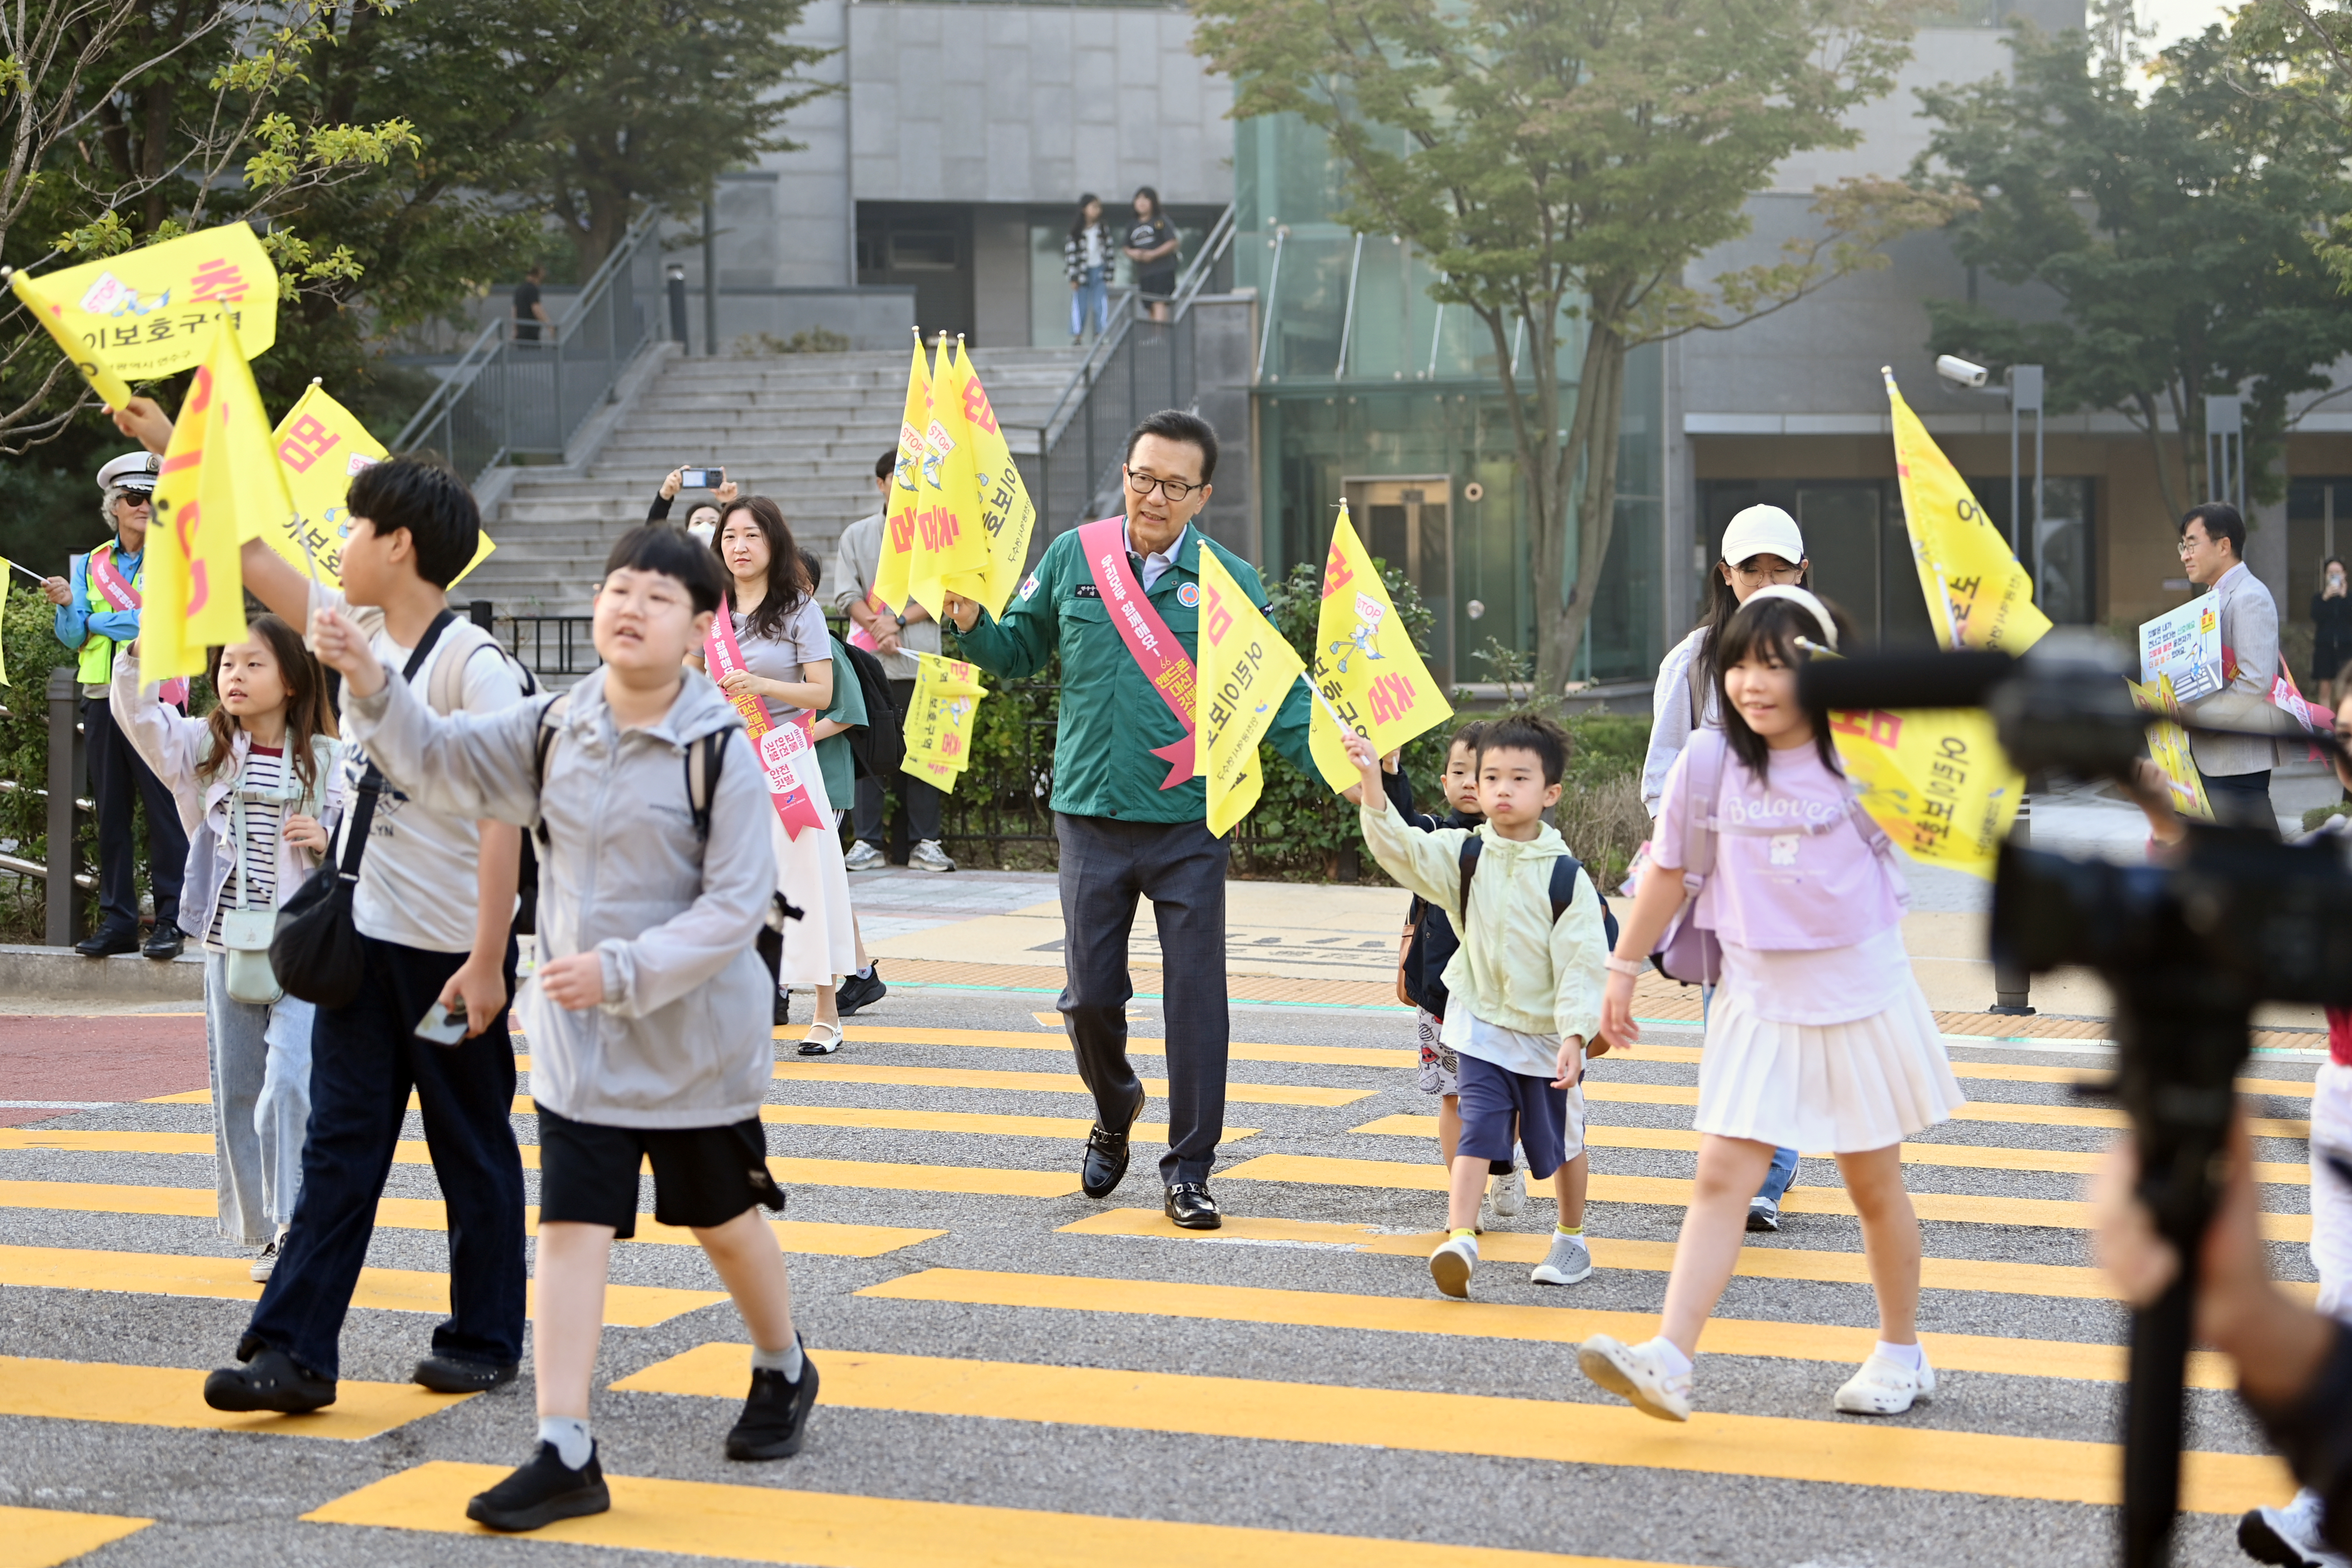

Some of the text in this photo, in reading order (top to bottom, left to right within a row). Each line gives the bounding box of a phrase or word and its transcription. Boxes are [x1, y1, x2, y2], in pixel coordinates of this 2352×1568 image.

[87, 279, 116, 313] STOP
[277, 413, 341, 474] 멈
[901, 427, 923, 452] STOP
[929, 425, 950, 451] STOP
[917, 504, 960, 553] 춤
[1101, 554, 1127, 600] 우리모두
[1356, 596, 1382, 619] STOP
[711, 613, 722, 639] 모두
[2162, 621, 2172, 632] 내가
[2148, 637, 2161, 649] 건너고
[2173, 633, 2191, 648] 운전자가
[1154, 658, 1190, 689] 핸드폰
[1169, 673, 1194, 697] 대신
[738, 701, 758, 716] 대신
[1368, 672, 1416, 726] 춤
[747, 723, 769, 740] 들고
[784, 732, 799, 753] 교통
[794, 729, 805, 748] 어린이
[764, 742, 781, 762] 깃발
[775, 737, 790, 758] 안전
[942, 732, 961, 757] 춤
[770, 764, 790, 780] 안전
[774, 774, 795, 790] 깃발
